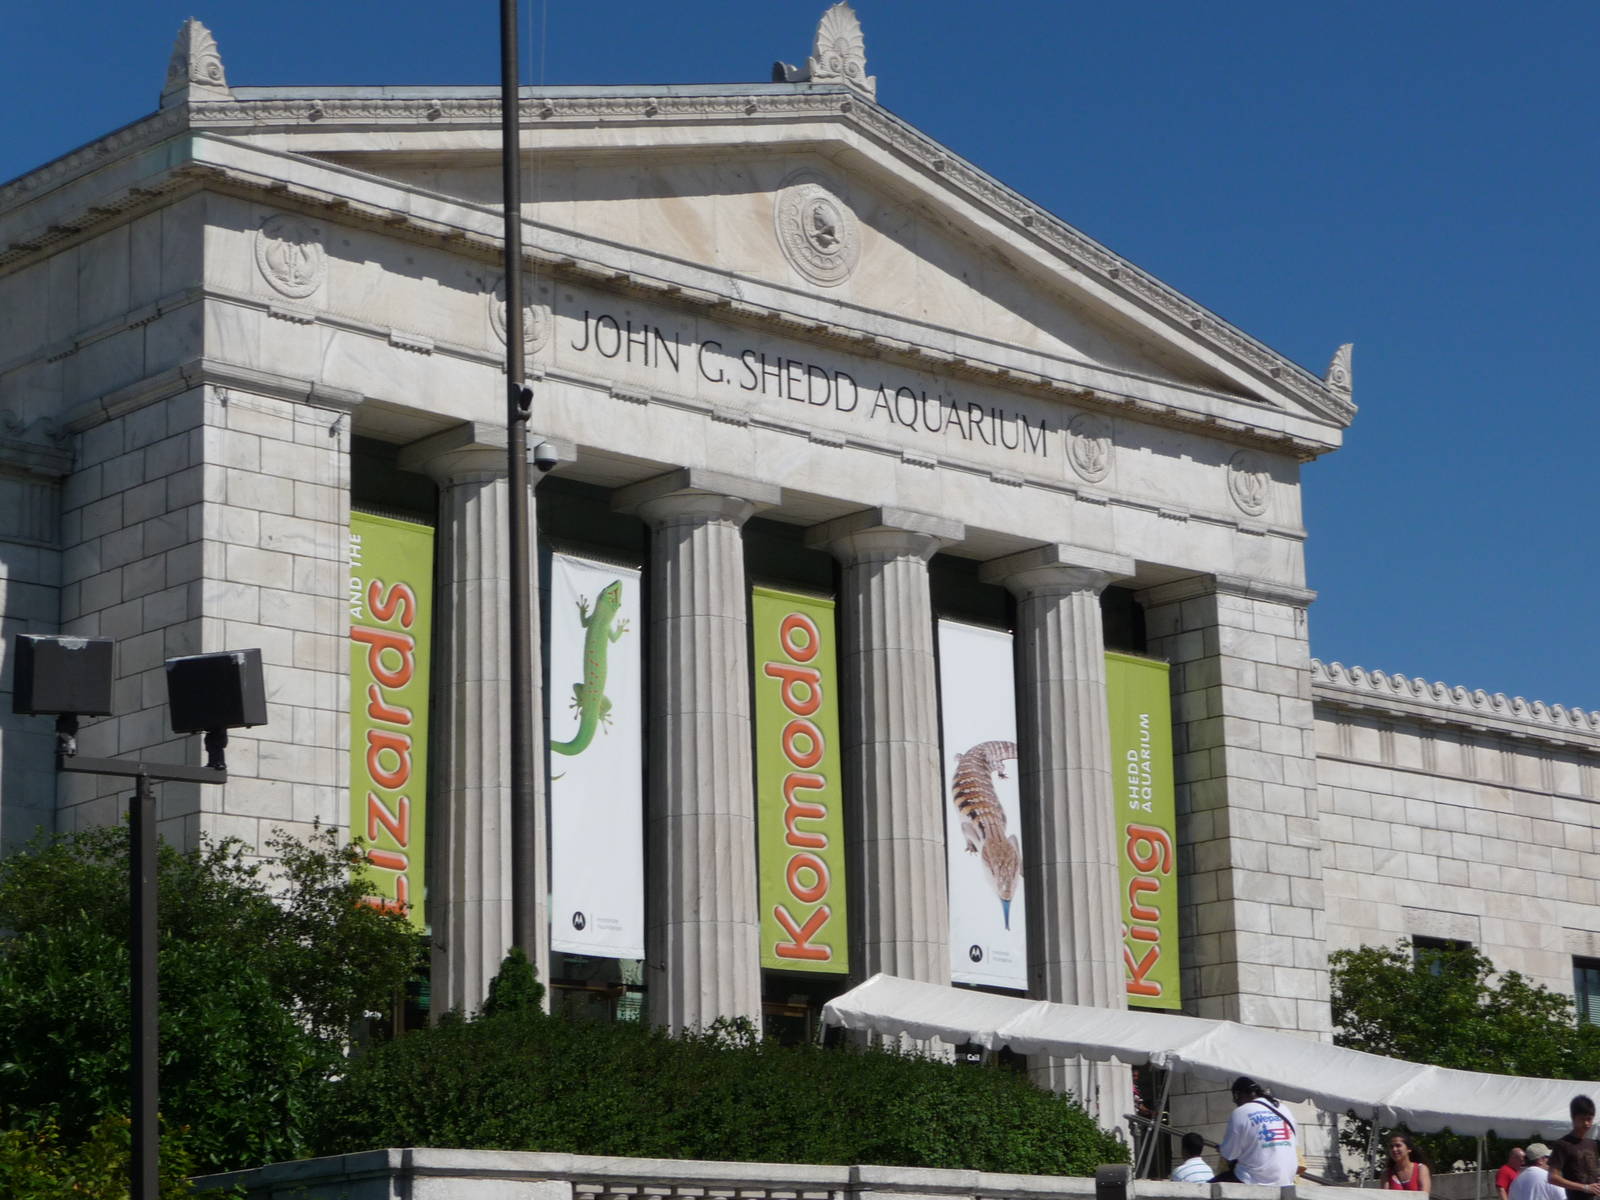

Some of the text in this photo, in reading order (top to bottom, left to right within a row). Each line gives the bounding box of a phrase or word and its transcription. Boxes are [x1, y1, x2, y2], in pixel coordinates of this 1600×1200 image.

[571, 310, 1047, 457] JOHN G. SHEDD AQUARIUM
[350, 534, 362, 619] AND THE
[350, 578, 416, 919] Lizards
[763, 612, 832, 961] Komodo
[1127, 749, 1140, 810] SHEDD
[1138, 713, 1152, 812] AQUARIUM
[1122, 823, 1172, 997] King
